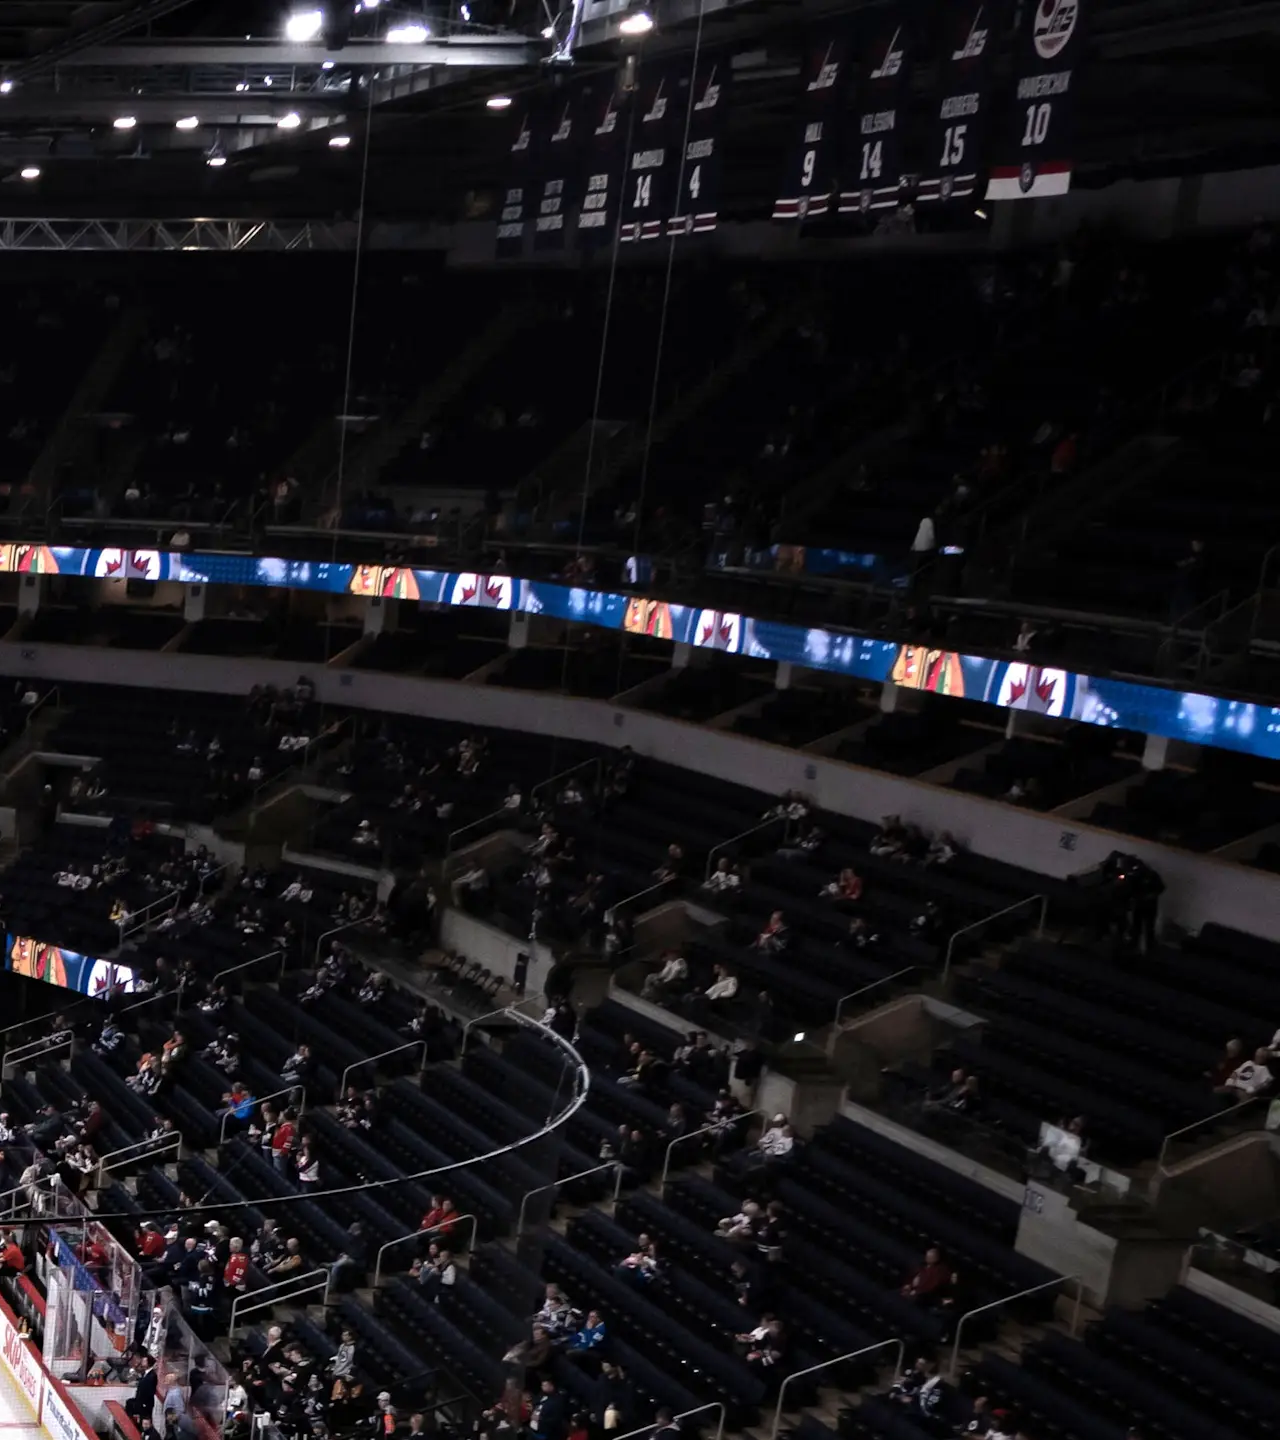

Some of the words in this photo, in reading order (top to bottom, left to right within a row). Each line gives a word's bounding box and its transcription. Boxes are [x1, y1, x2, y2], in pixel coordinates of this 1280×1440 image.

[1021, 102, 1051, 147] 10
[859, 140, 883, 180] 14
[940, 124, 968, 167] 15
[689, 163, 701, 199] 4
[801, 150, 816, 187] 9
[633, 173, 652, 208] 14
